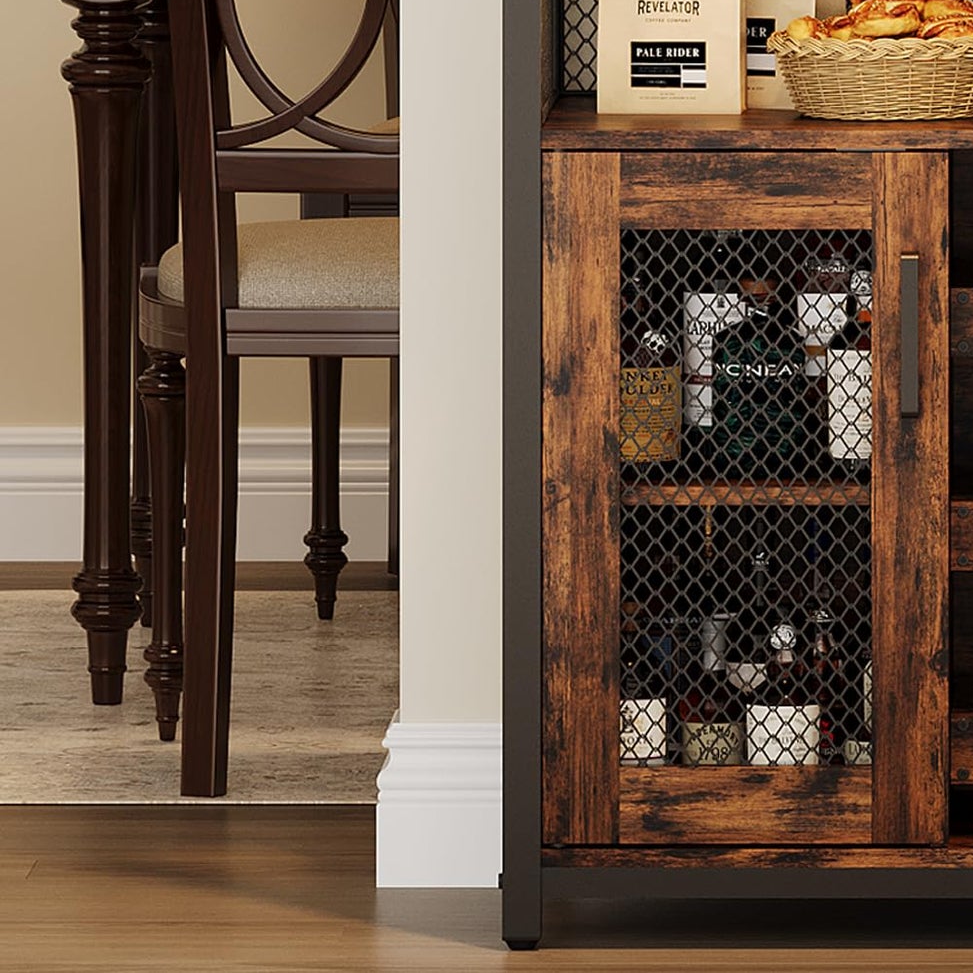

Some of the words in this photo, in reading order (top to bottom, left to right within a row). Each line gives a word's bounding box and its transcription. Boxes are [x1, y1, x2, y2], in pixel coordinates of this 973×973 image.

[637, 0, 700, 16] REVELATOR
[635, 47, 662, 58] PALE
[666, 47, 700, 58] RIDER
